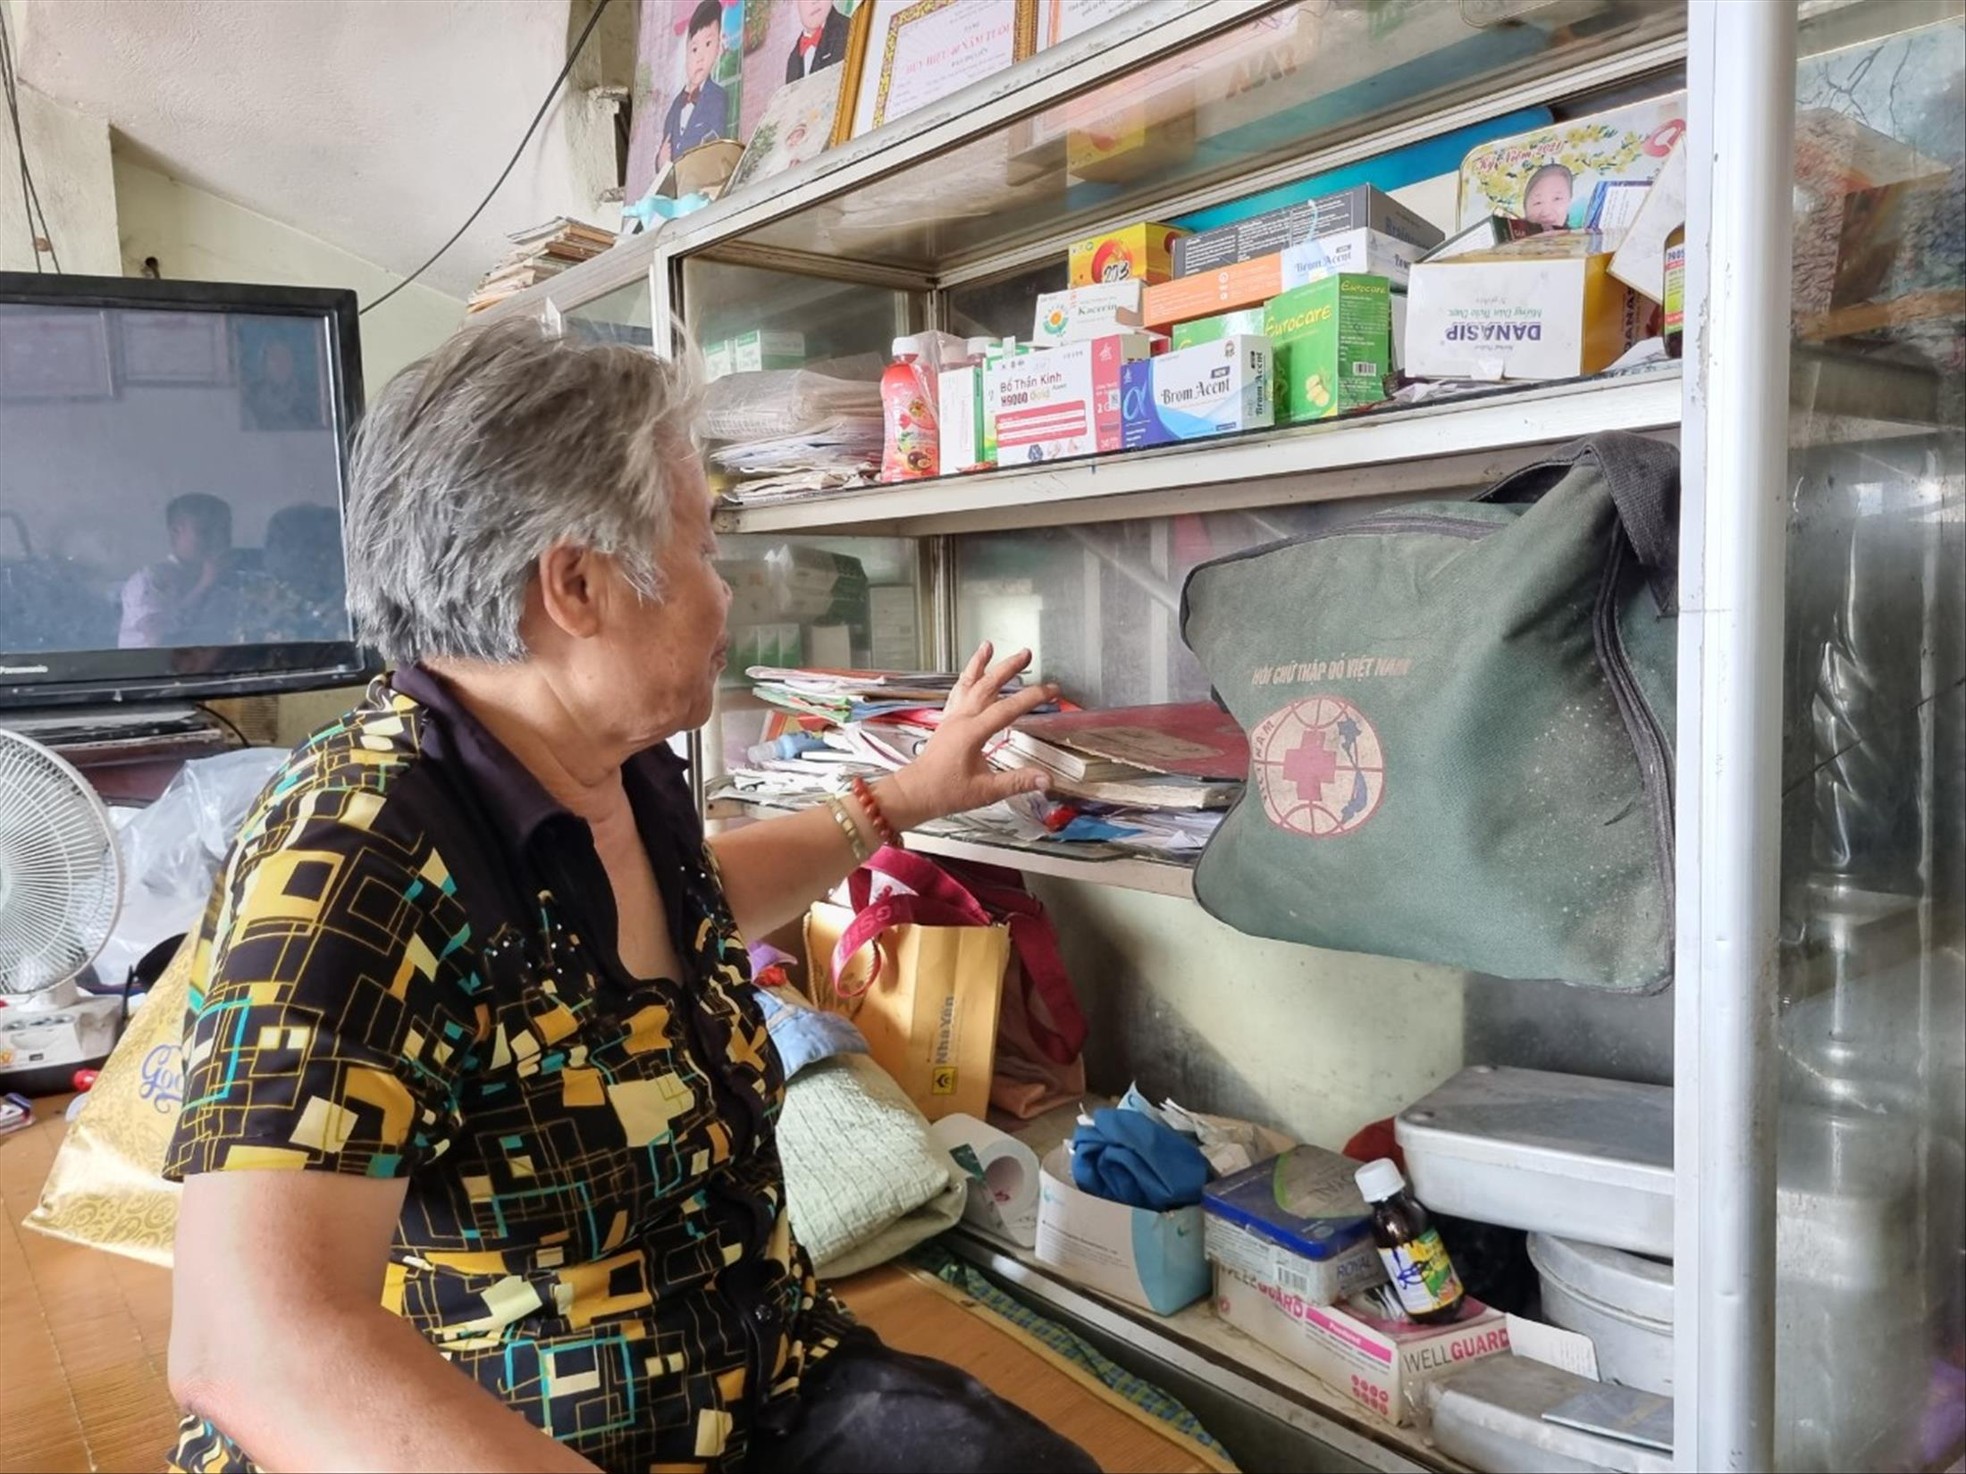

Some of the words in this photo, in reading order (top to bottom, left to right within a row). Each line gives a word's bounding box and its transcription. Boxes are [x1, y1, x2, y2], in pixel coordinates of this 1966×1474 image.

[1265, 304, 1332, 337] Eurocare
[1446, 322, 1542, 342] DANASIP
[1041, 371, 1062, 385] Kinh
[1161, 386, 1193, 405] Brom
[1195, 378, 1230, 399] Accent
[1404, 1328, 1509, 1374] WELLGUARD
